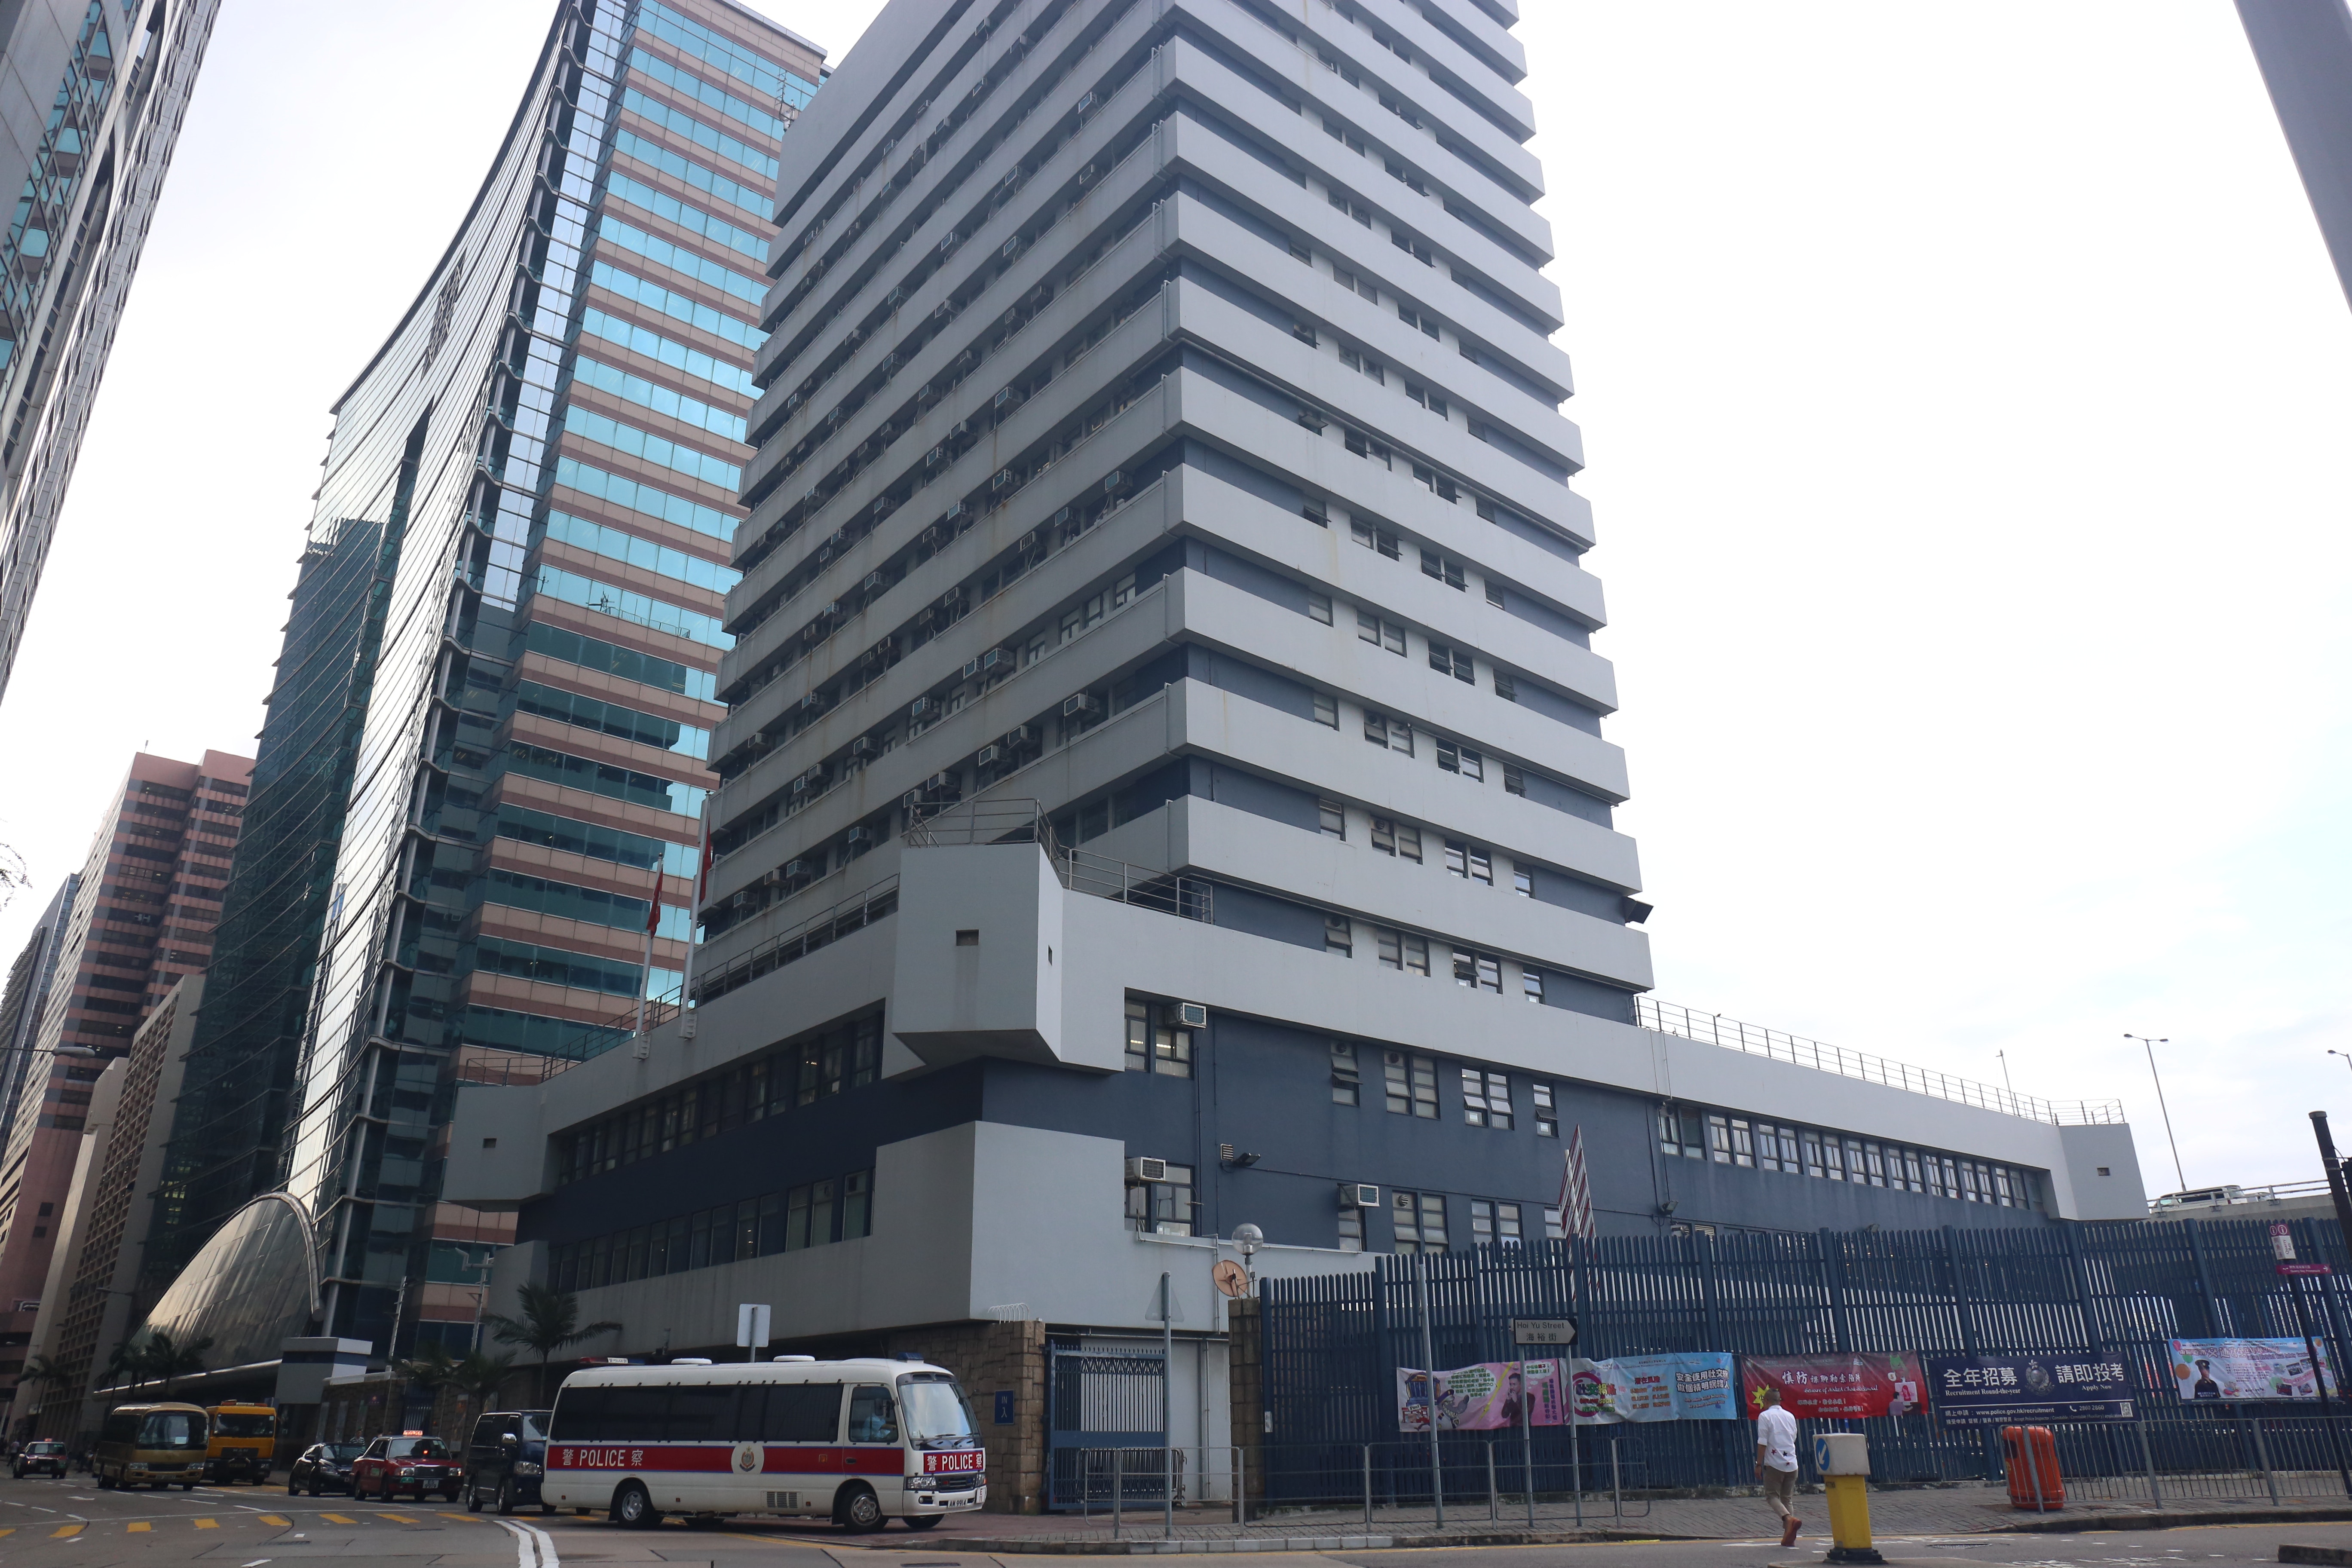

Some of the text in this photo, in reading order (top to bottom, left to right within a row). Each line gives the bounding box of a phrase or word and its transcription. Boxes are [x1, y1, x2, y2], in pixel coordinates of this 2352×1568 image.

[1526, 1333, 1557, 1341] 海裕街
[1943, 1367, 2018, 1387] 全年招募
[2055, 1363, 2125, 1384] 請即投考
[1001, 1407, 1007, 1418] 入
[562, 1449, 643, 1467] 警 POLICE 察
[927, 1453, 982, 1471] 警 POLICE 察
